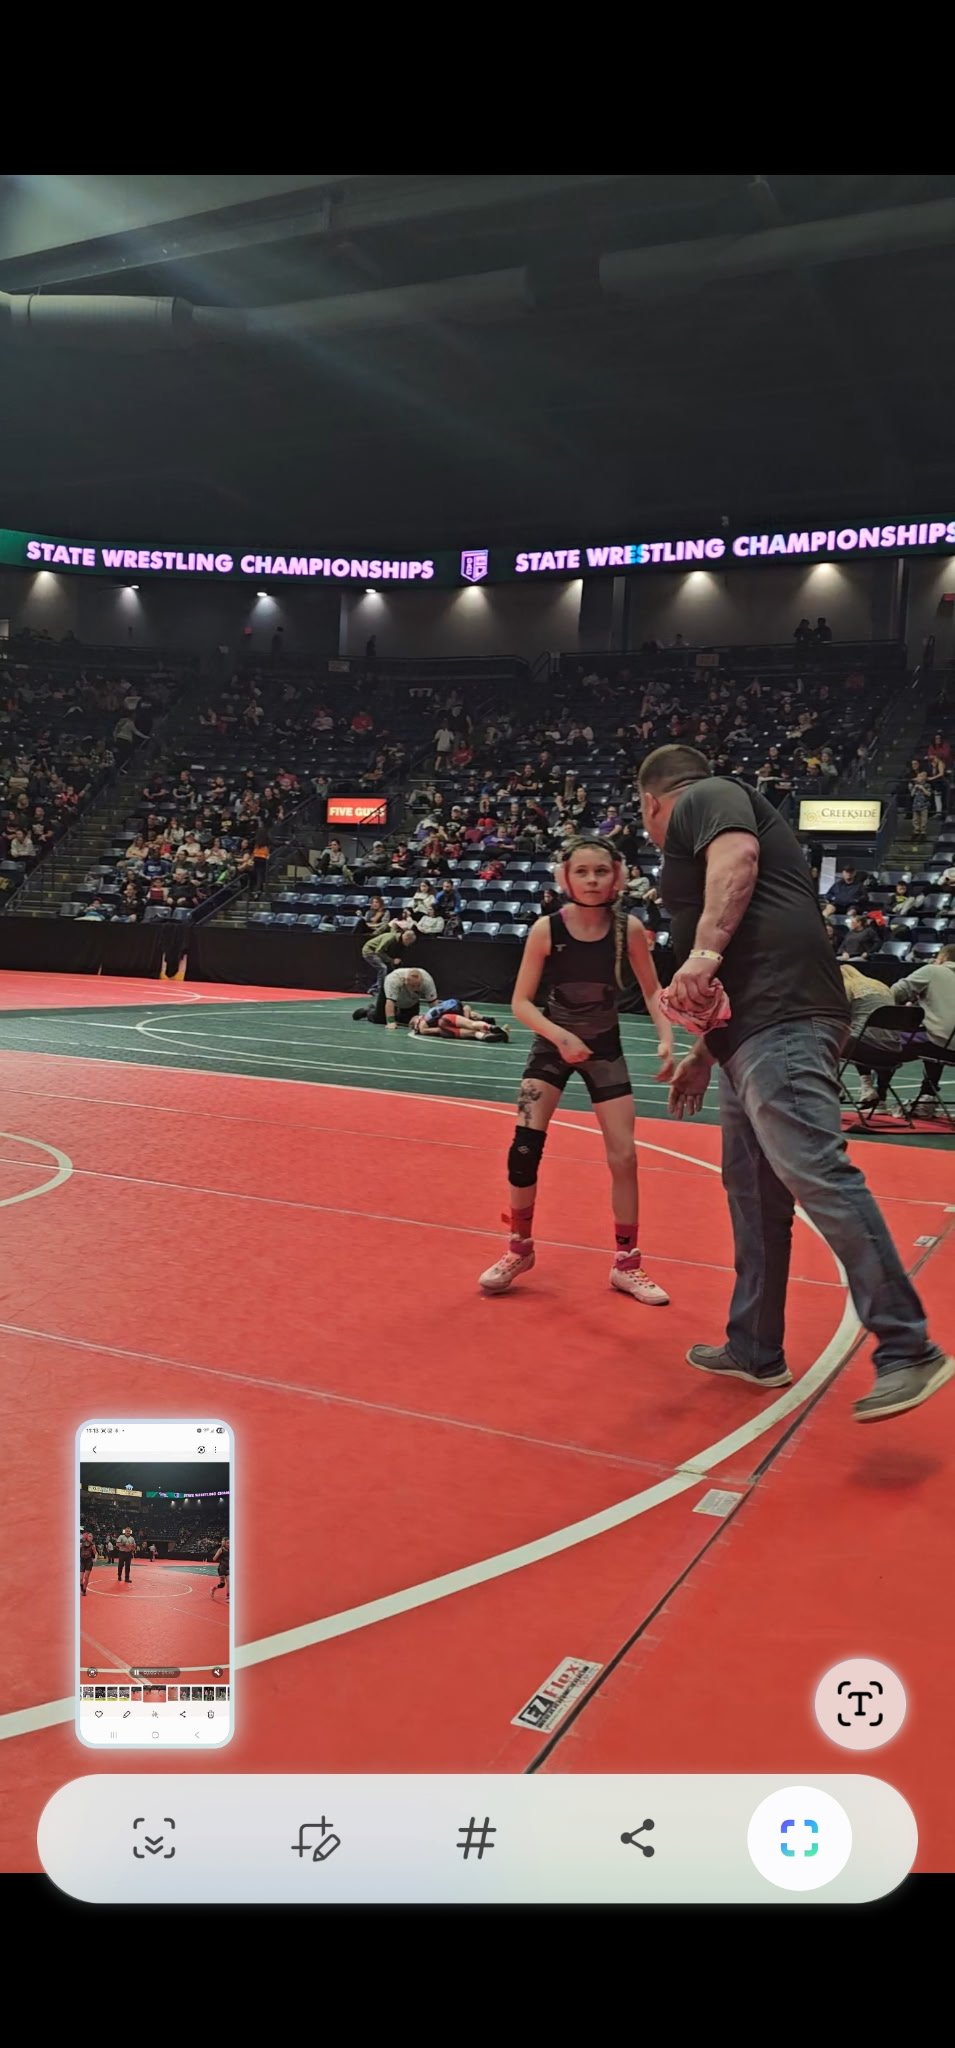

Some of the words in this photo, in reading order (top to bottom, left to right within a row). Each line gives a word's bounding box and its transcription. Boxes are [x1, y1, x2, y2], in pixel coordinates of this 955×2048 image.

[27, 541, 95, 567] STATE
[102, 549, 234, 573] WRESTLING
[241, 555, 434, 579] CHAMPIONSHIPS
[515, 549, 580, 572] STATE
[587, 538, 725, 567] WRESTLING
[732, 521, 955, 557] CHAMPIONSHIPS
[329, 807, 353, 816] FIVE
